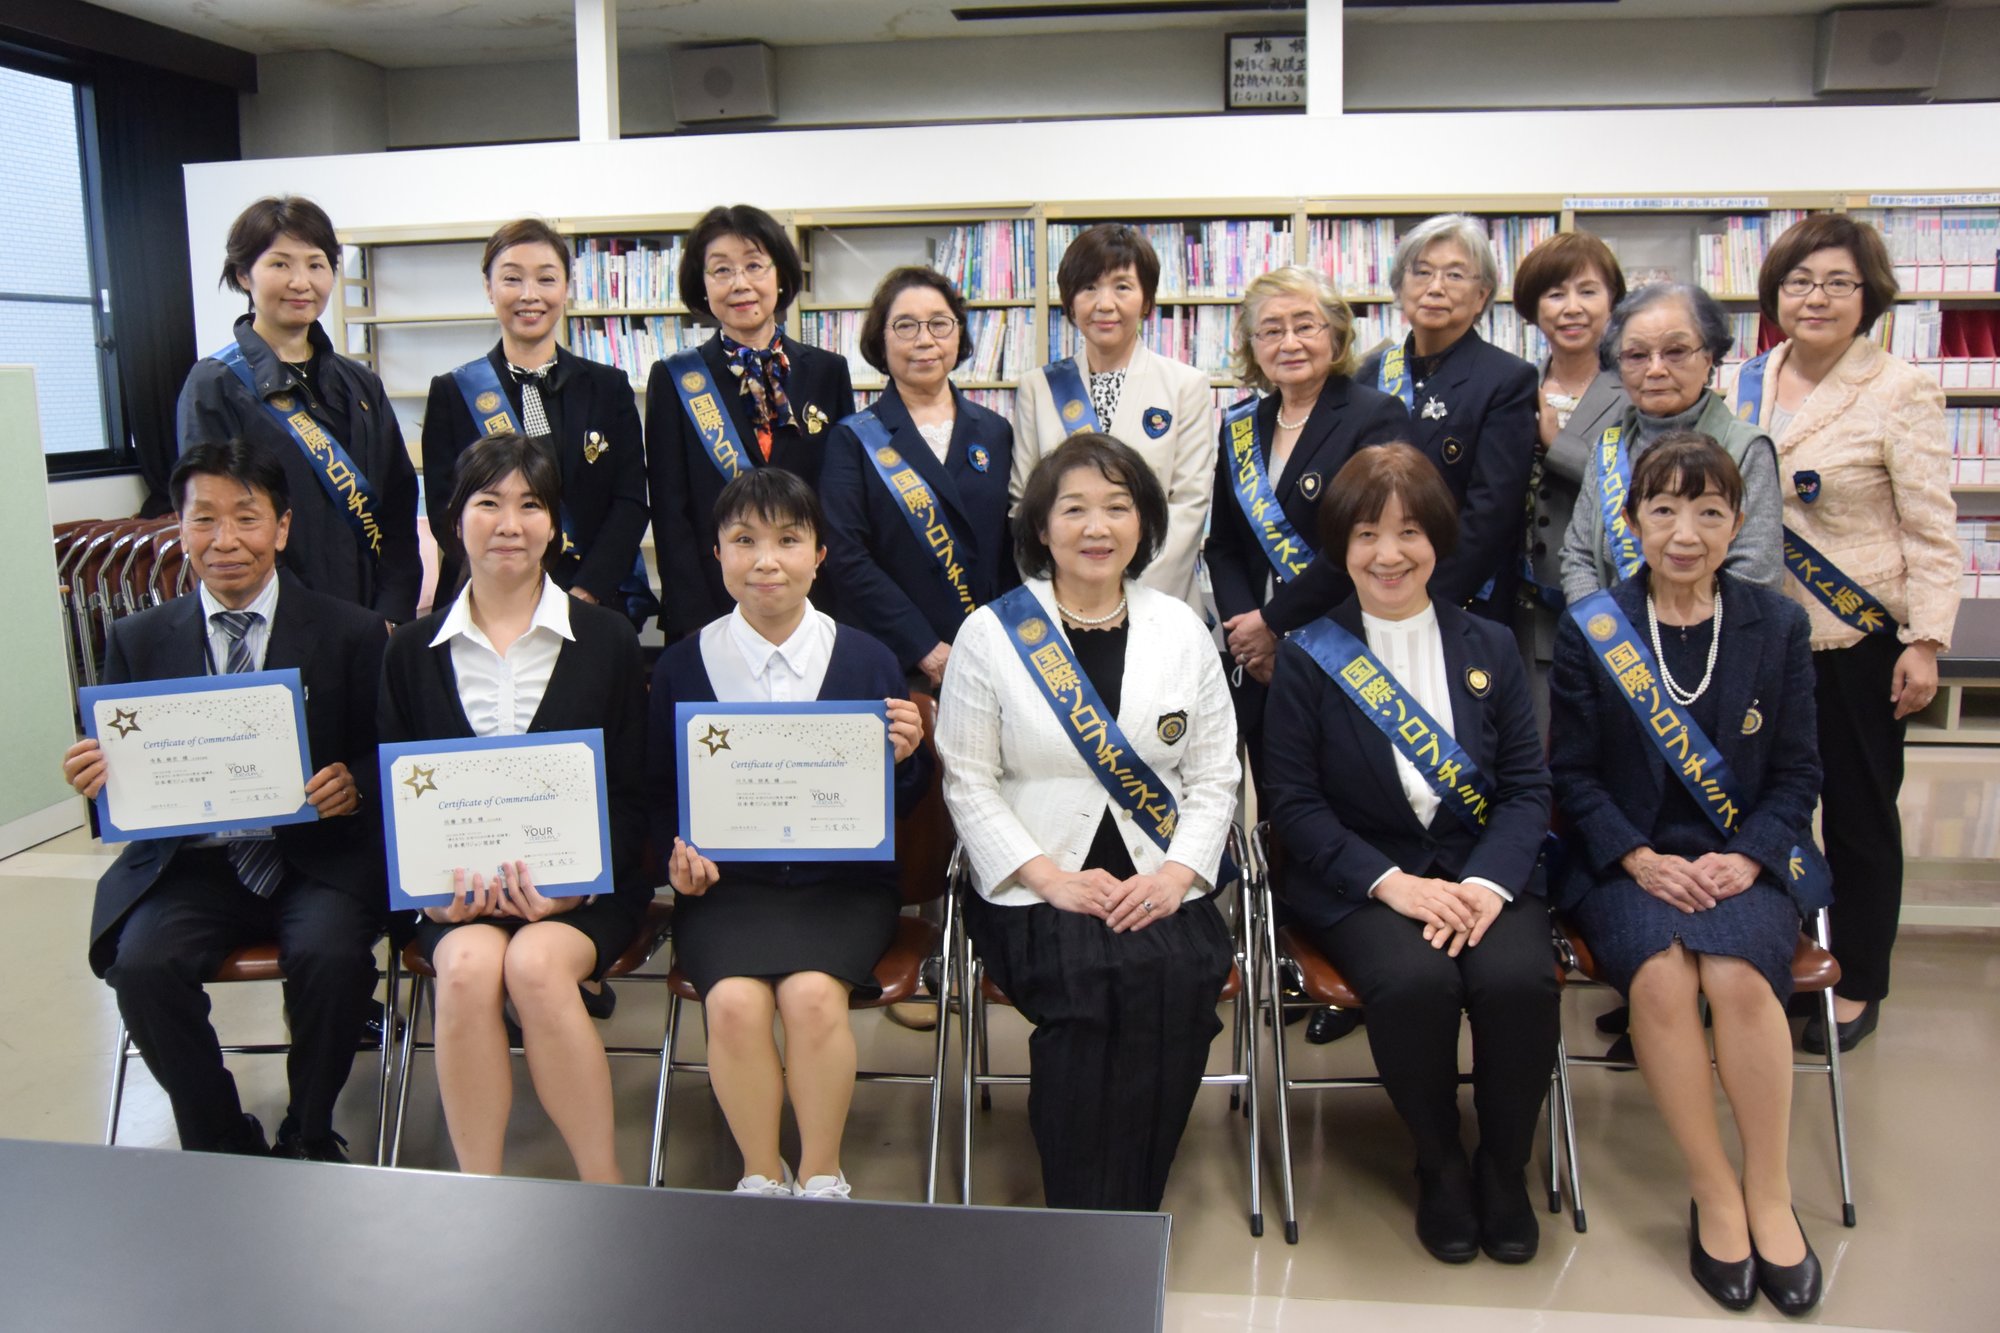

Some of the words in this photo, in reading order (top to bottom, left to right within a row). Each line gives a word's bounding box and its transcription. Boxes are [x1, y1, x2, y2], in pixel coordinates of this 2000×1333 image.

[689, 393, 744, 480] 国際ソロプ
[1231, 416, 1308, 576] 国際ソロプチミスト
[143, 739, 186, 750] Certificate
[188, 737, 198, 748] of
[198, 732, 257, 745] Commendation
[1604, 640, 1741, 834] 国際ソロプチミス
[228, 764, 256, 774] YOUR
[731, 760, 775, 770] Certificate
[776, 760, 785, 770] of
[786, 759, 845, 769] Commendation
[438, 798, 482, 810] Certificate
[484, 797, 494, 808] of
[495, 793, 556, 805] Commendation
[812, 792, 840, 801] YOUR
[524, 827, 553, 836] YOUR
